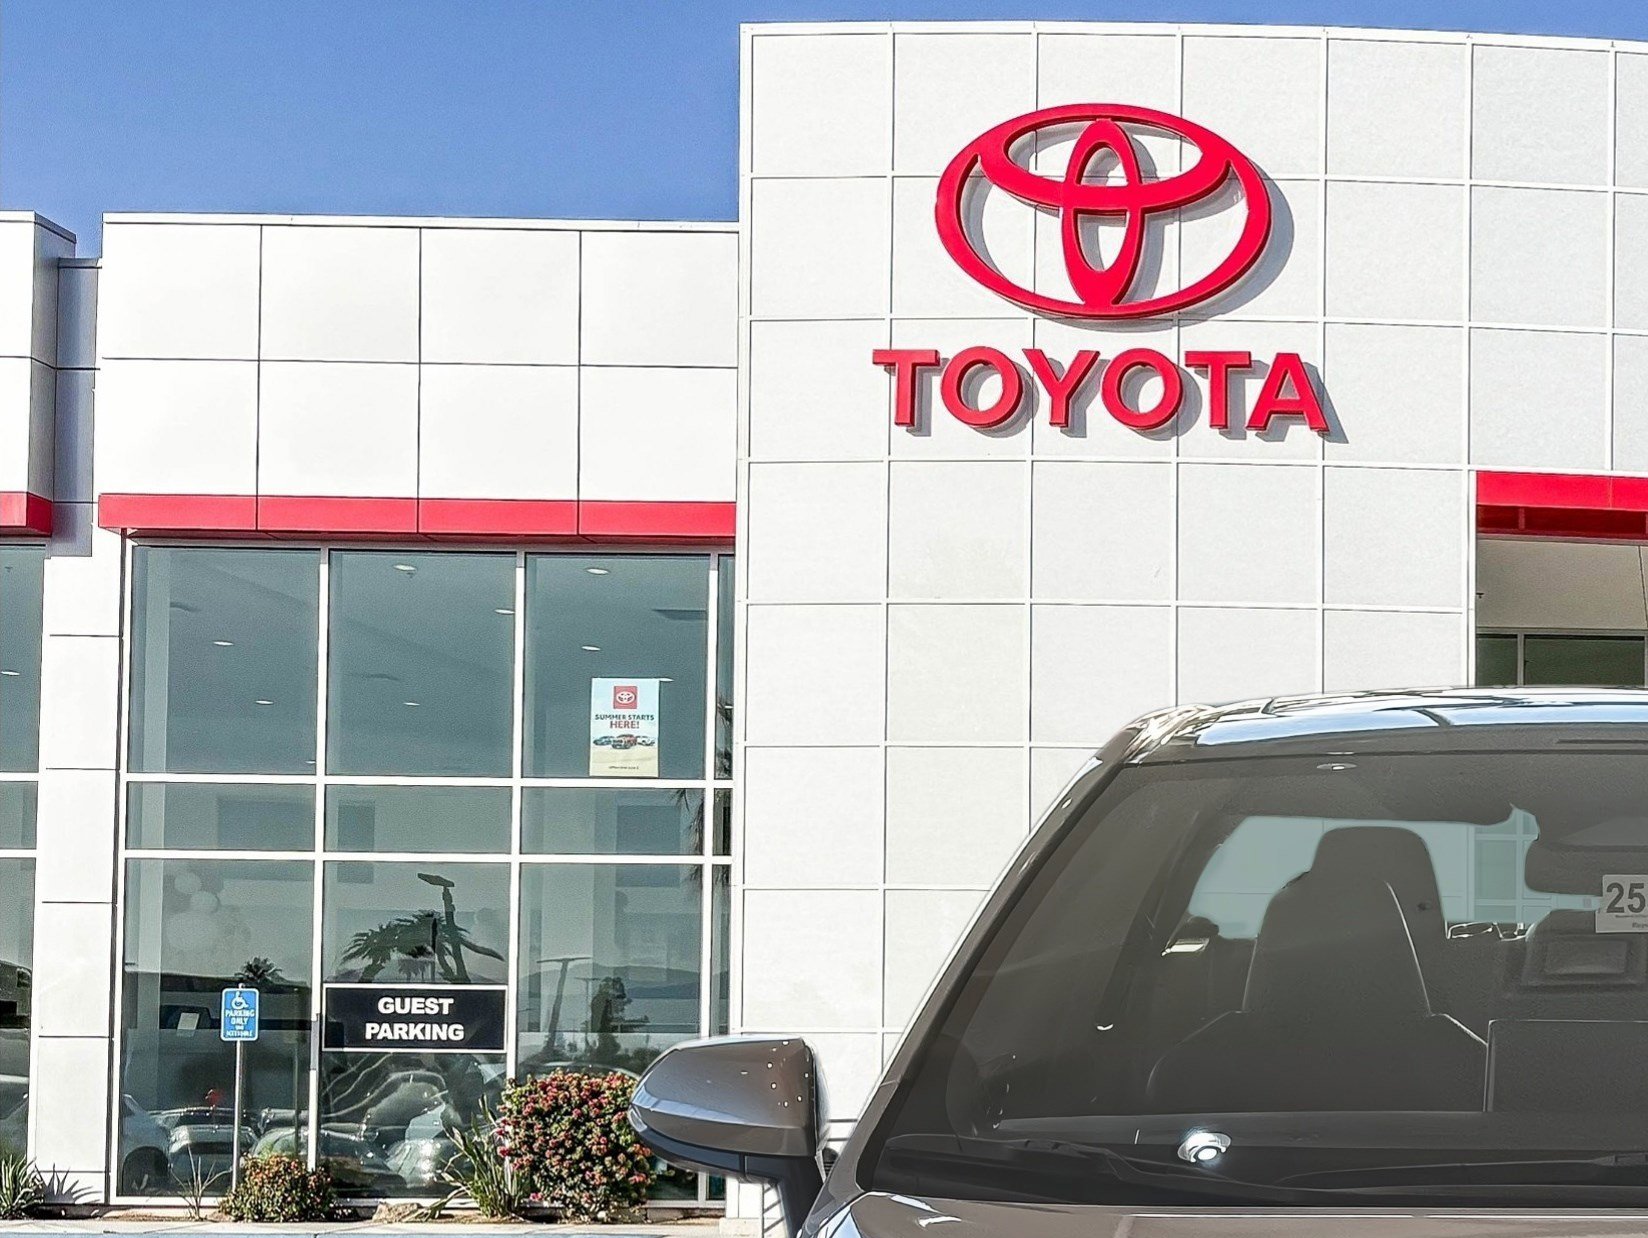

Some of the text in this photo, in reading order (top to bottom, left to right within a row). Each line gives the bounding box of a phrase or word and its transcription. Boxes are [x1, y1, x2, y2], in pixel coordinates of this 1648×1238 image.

[872, 345, 1330, 434] TOYOTA
[609, 720, 640, 729] HERE!
[377, 997, 455, 1015] GUEST
[225, 1009, 255, 1017] PARKING
[230, 1017, 249, 1025] ONLY
[365, 1022, 465, 1041] PARKING
